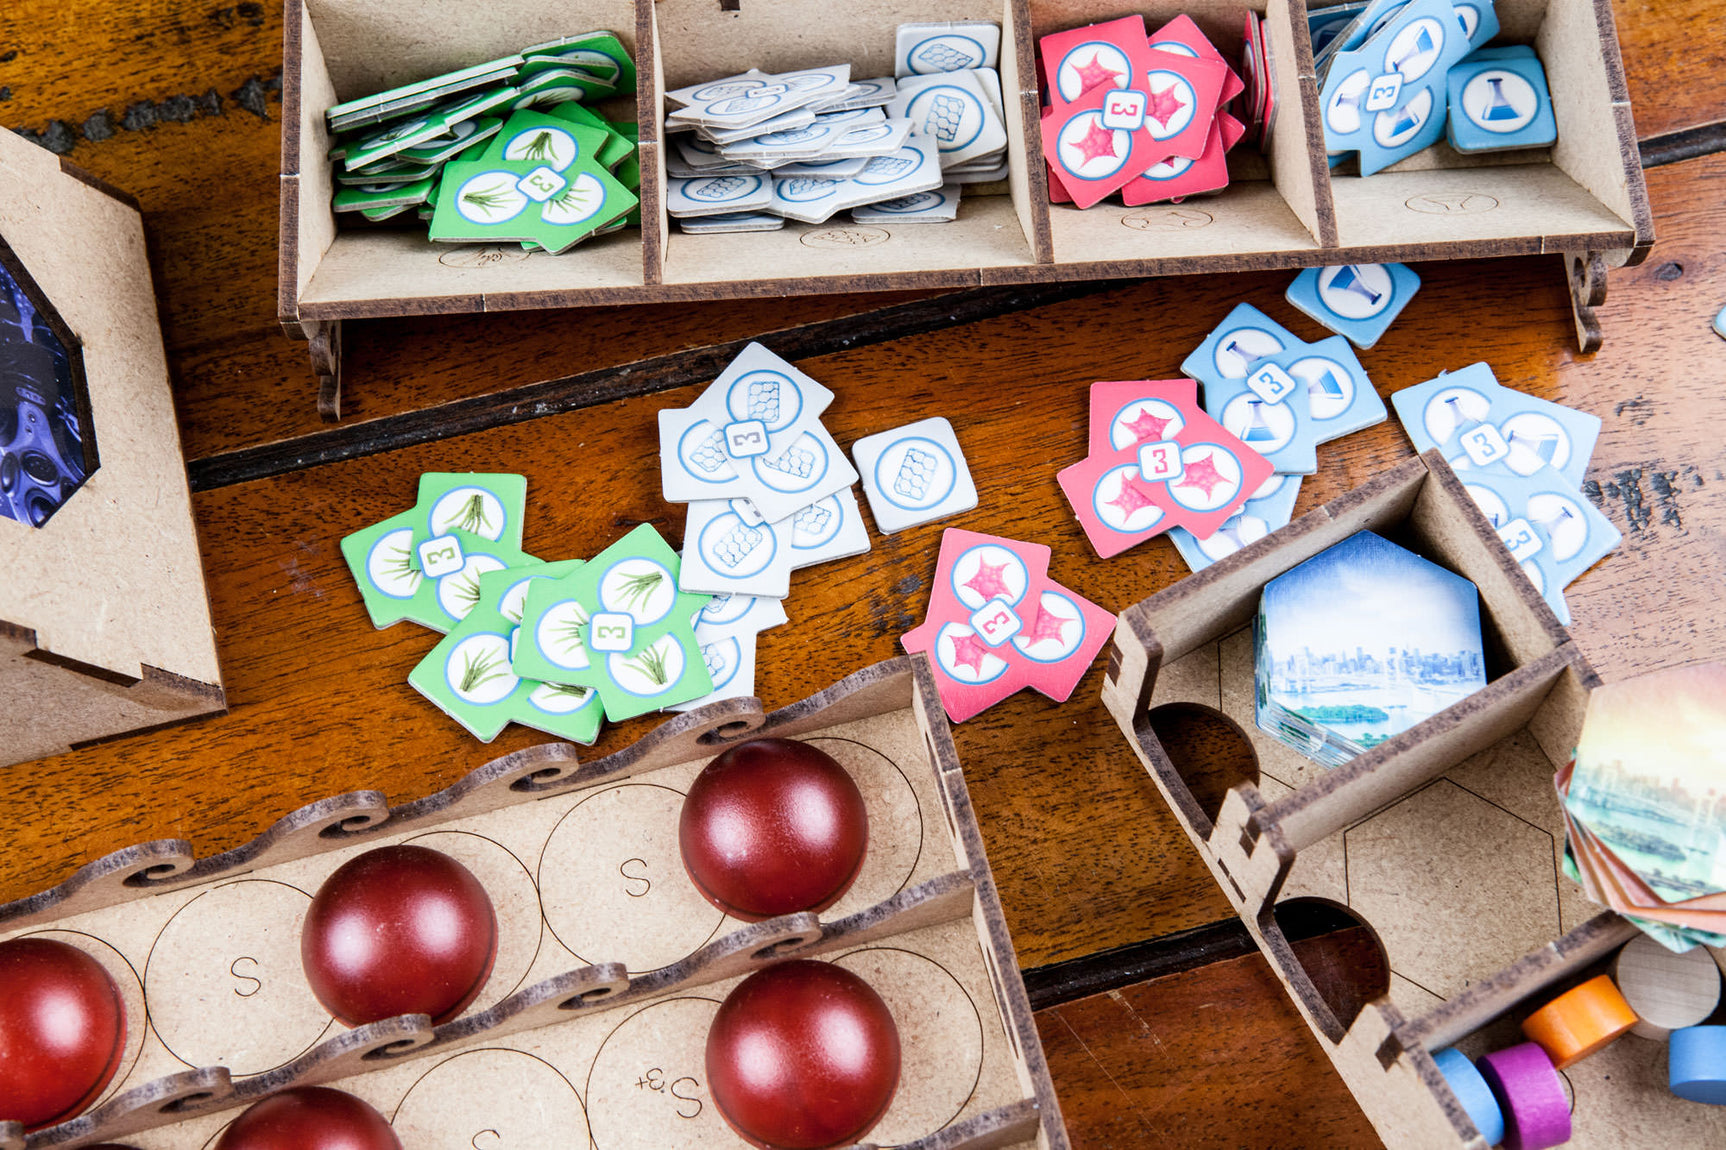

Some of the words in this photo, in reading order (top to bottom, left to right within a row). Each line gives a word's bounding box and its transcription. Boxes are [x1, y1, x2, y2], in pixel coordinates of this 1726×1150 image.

[1372, 86, 1395, 99] 3
[1111, 103, 1138, 116] 3
[529, 175, 555, 192] 3
[1259, 372, 1284, 395] 3
[733, 431, 760, 446] 3
[1472, 433, 1496, 457] 3
[1152, 448, 1168, 473] 3
[1505, 530, 1532, 551] 3
[427, 547, 455, 565] 3
[597, 626, 625, 639] 3
[982, 611, 1010, 635] 3
[620, 858, 651, 897] S
[231, 956, 261, 997] S
